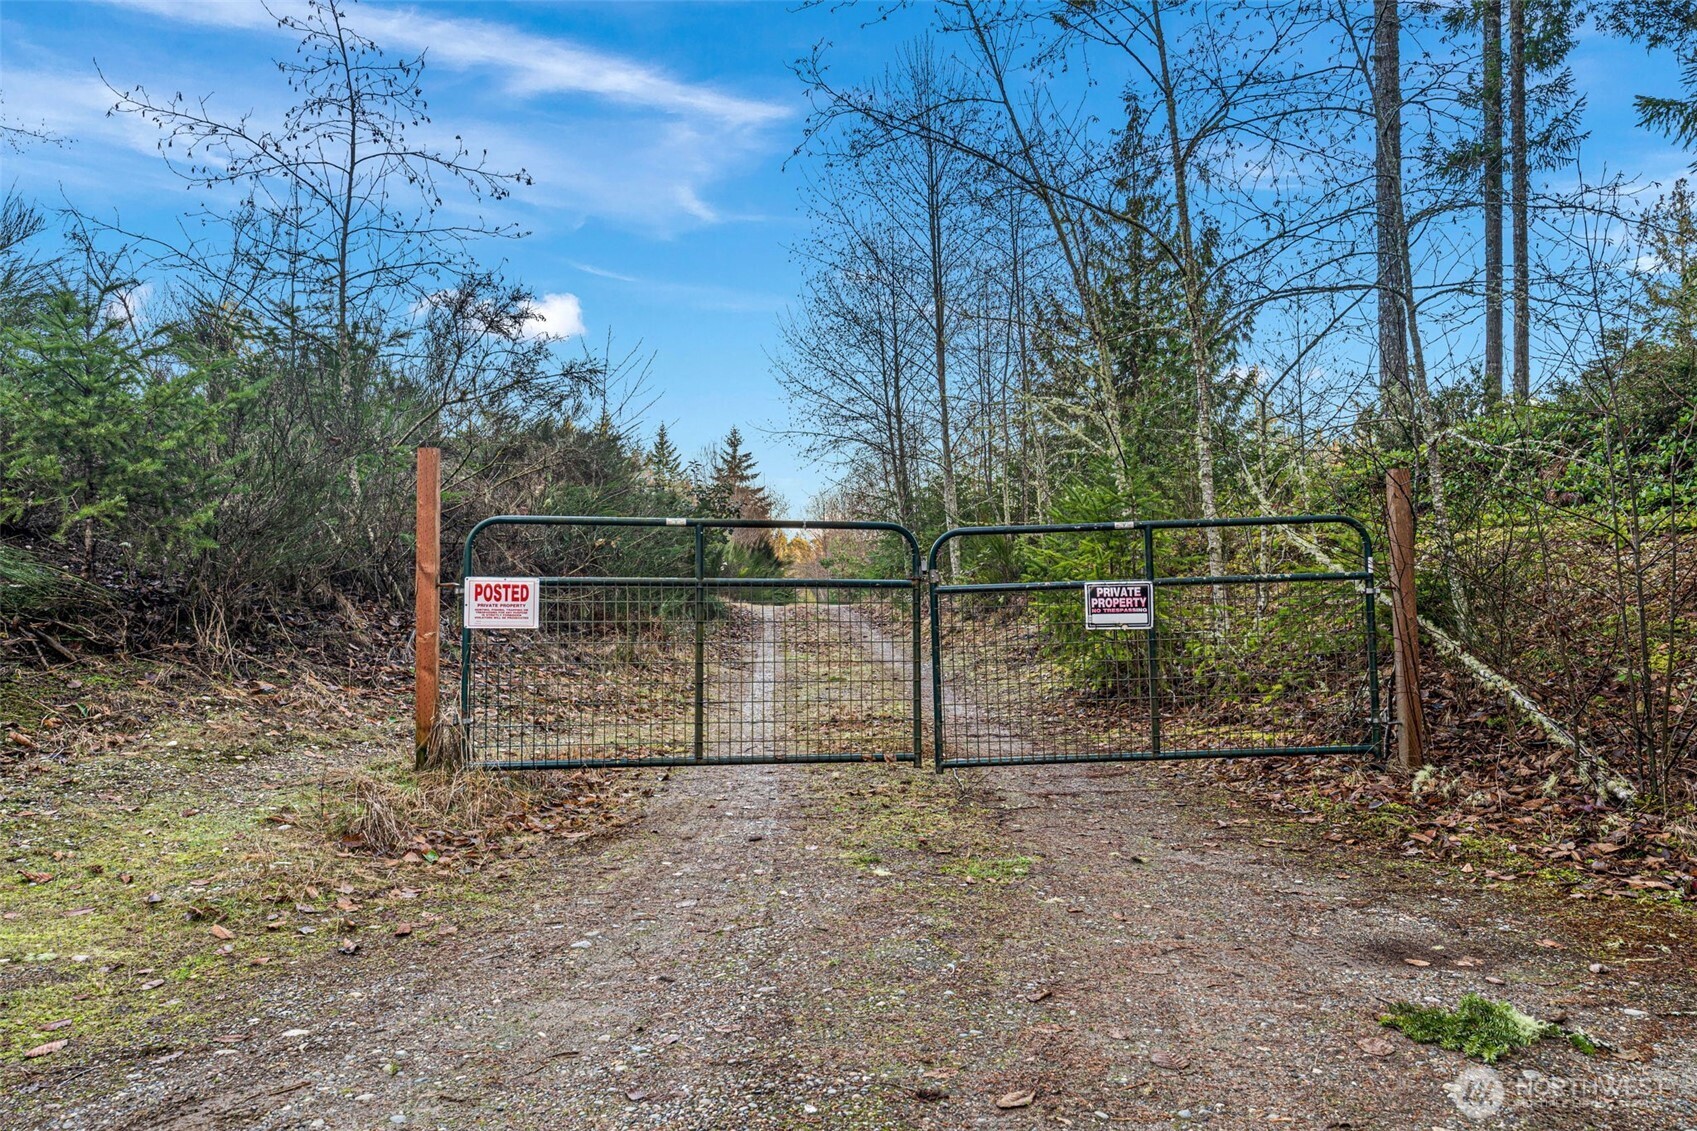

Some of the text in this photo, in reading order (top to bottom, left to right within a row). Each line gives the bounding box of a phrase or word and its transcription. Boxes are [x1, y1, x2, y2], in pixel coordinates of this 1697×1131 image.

[474, 583, 530, 602] POSTED
[1096, 587, 1141, 597] PRIVATE
[1091, 597, 1147, 608] PROPERTY
